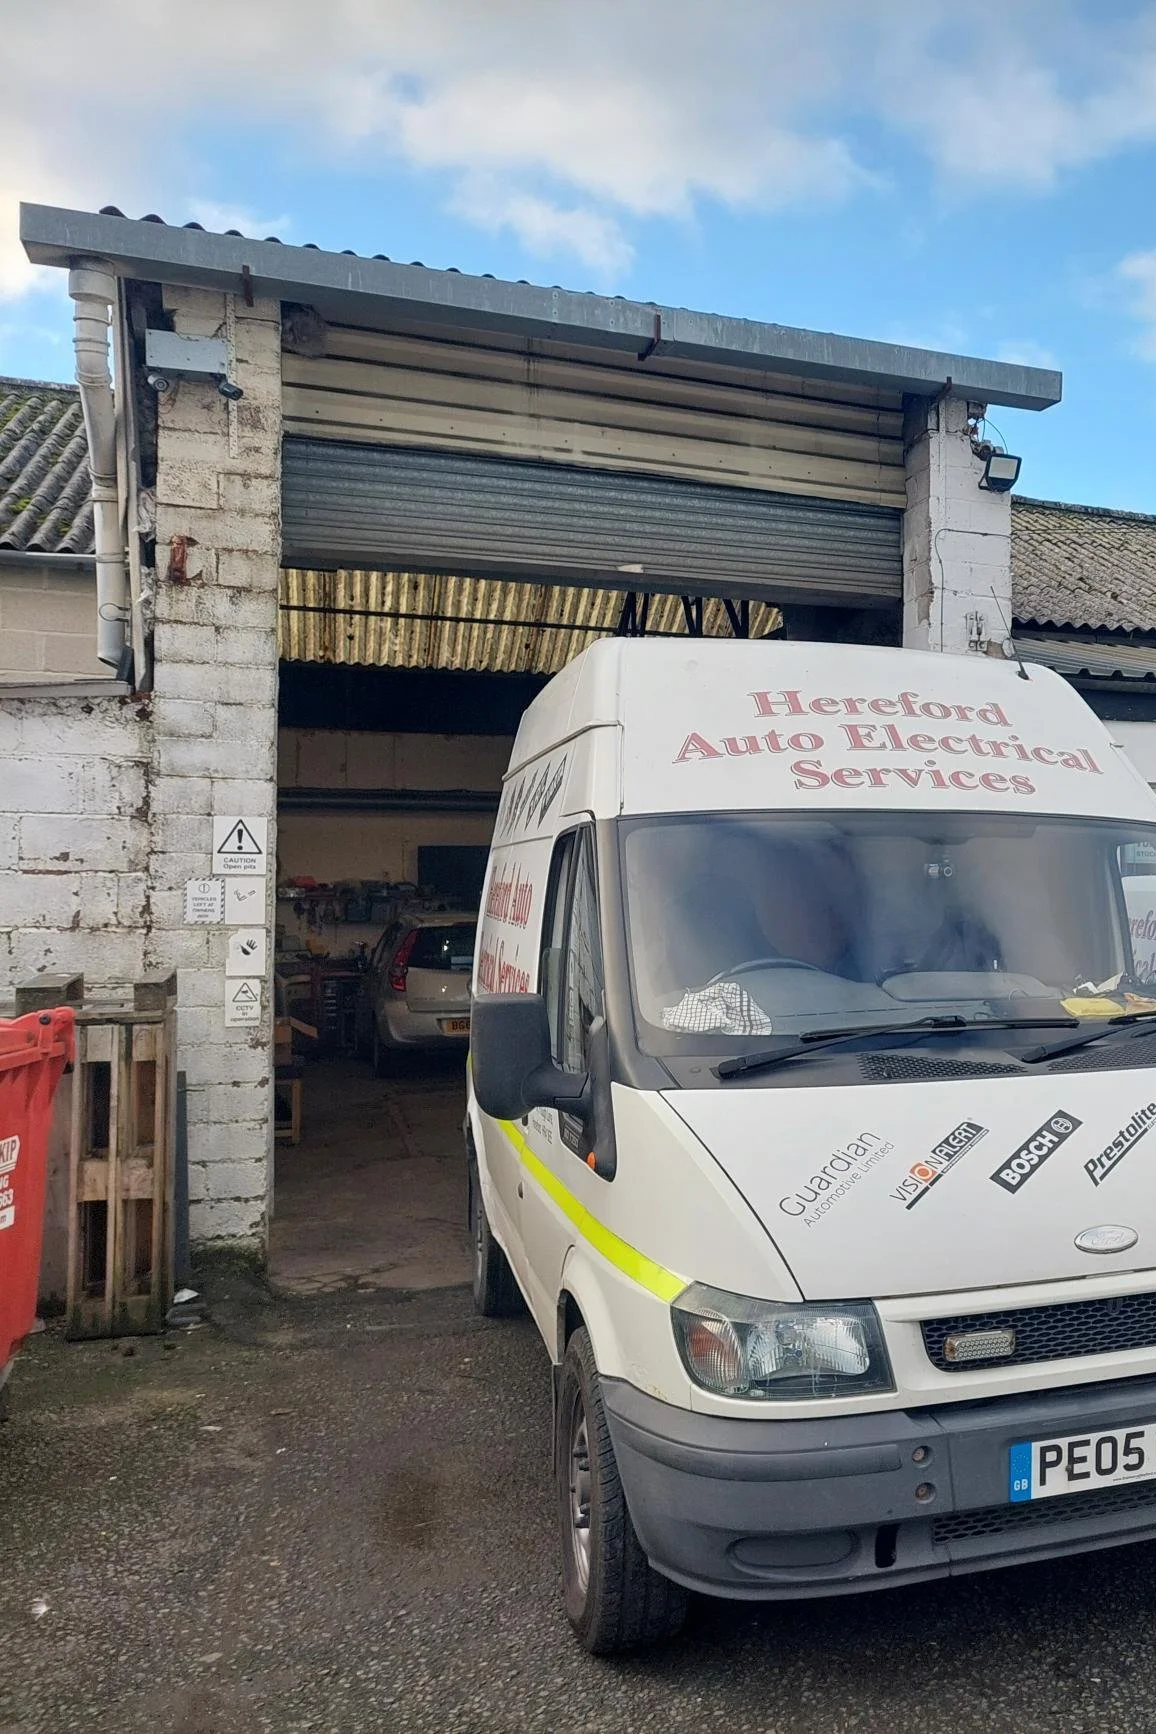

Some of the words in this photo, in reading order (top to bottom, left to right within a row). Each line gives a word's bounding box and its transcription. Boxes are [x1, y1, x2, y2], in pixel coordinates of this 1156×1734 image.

[747, 690, 1013, 728] Hereford
[672, 728, 824, 764] Auto
[838, 724, 1104, 774] Electrical
[790, 760, 1036, 795] Services
[223, 863, 242, 871] Open
[244, 863, 257, 871] pits
[779, 1131, 881, 1217] Guardian
[999, 1130, 1059, 1186] BOSCH
[803, 1171, 862, 1228] Automotive
[857, 1141, 895, 1174] Limited
[1039, 1430, 1146, 1487] PE05
[1013, 1478, 1029, 1491] GB
